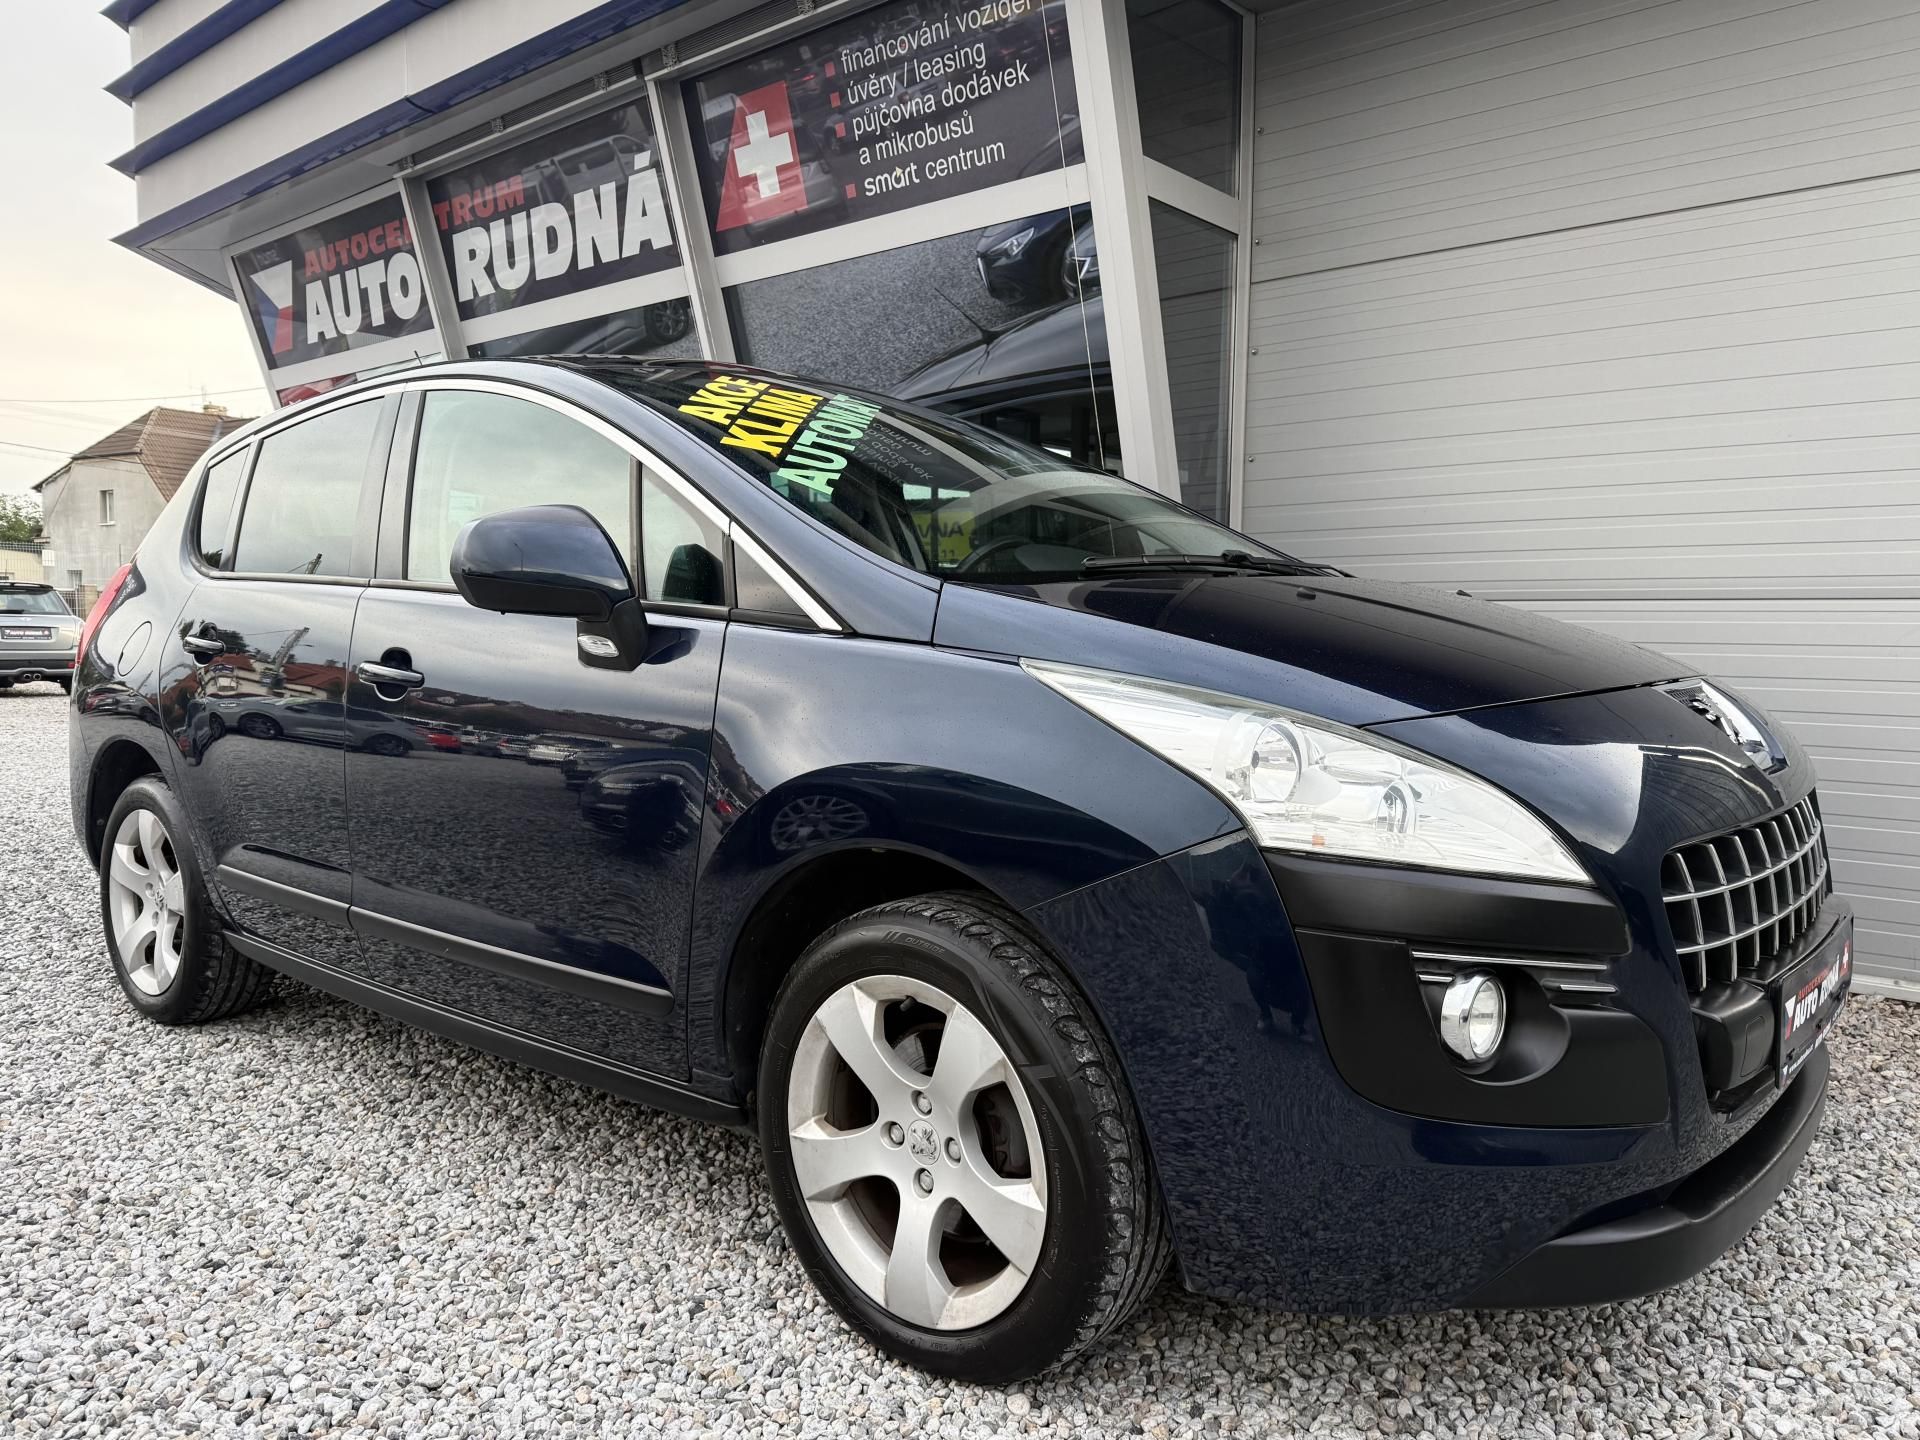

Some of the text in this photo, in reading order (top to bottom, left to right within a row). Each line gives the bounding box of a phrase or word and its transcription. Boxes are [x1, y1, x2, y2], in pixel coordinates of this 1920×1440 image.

[840, 13, 950, 74] financování
[847, 73, 897, 104] úvěry
[913, 42, 986, 82] leasing
[852, 59, 1031, 141] půjčovna dodávek
[859, 109, 974, 165] a mikrobusů
[864, 142, 1006, 196] smart centrum
[305, 150, 674, 344] AUTO RUDNÁ
[677, 375, 770, 425] AKCE
[719, 388, 824, 458] KLIMA
[776, 393, 882, 496] AUTOMAT
[1793, 987, 1818, 1032] AUTO
